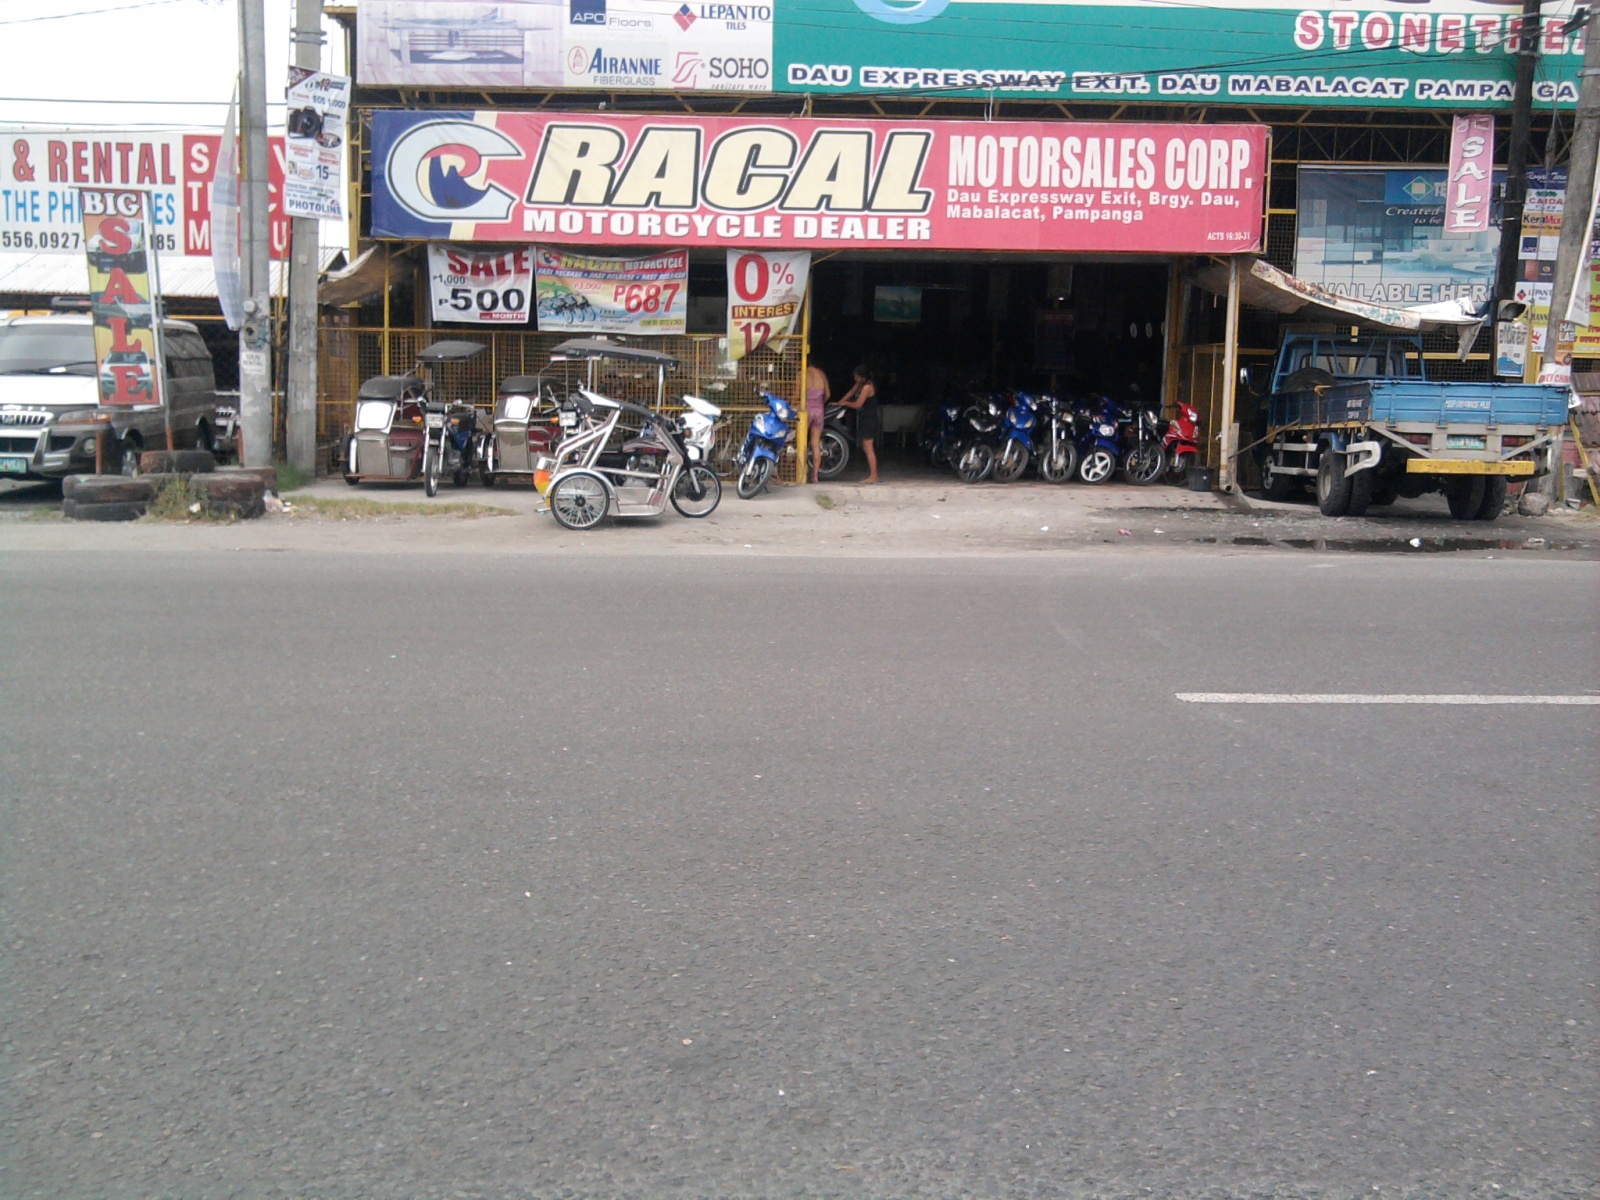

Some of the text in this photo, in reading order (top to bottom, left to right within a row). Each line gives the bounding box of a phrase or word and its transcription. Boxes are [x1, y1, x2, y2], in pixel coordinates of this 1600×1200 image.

[572, 12, 606, 23] APO
[609, 17, 652, 27] Floors
[701, 4, 771, 20] LEPANTO
[725, 21, 747, 30] TILES
[587, 47, 662, 75] AIRANNIE
[709, 57, 769, 79] SOHO
[593, 75, 656, 86] FIBERGLASS
[790, 66, 1575, 100] DAU EXPRESSWAY EXIT. DAU MABALACAT PAMPAGA
[13, 139, 35, 182] &
[49, 140, 176, 184] RENTAL
[316, 164, 329, 180] 15
[525, 125, 934, 213] RACAL
[949, 135, 1252, 190] MOTORSALES CORP.
[1452, 136, 1488, 228] SALE
[2, 190, 40, 222] THE
[82, 191, 141, 216] BIG
[947, 188, 1240, 208] Dau Expressway Exit, Brgy. Dau,
[1386, 206, 1442, 216] Created
[523, 209, 931, 240] MOTORCYCLE DEALER
[946, 204, 1143, 224] Mabalacat, Pampanga
[448, 248, 531, 277] SALE
[98, 217, 147, 405] SALE
[614, 283, 680, 314] P687
[740, 322, 771, 354] 12
